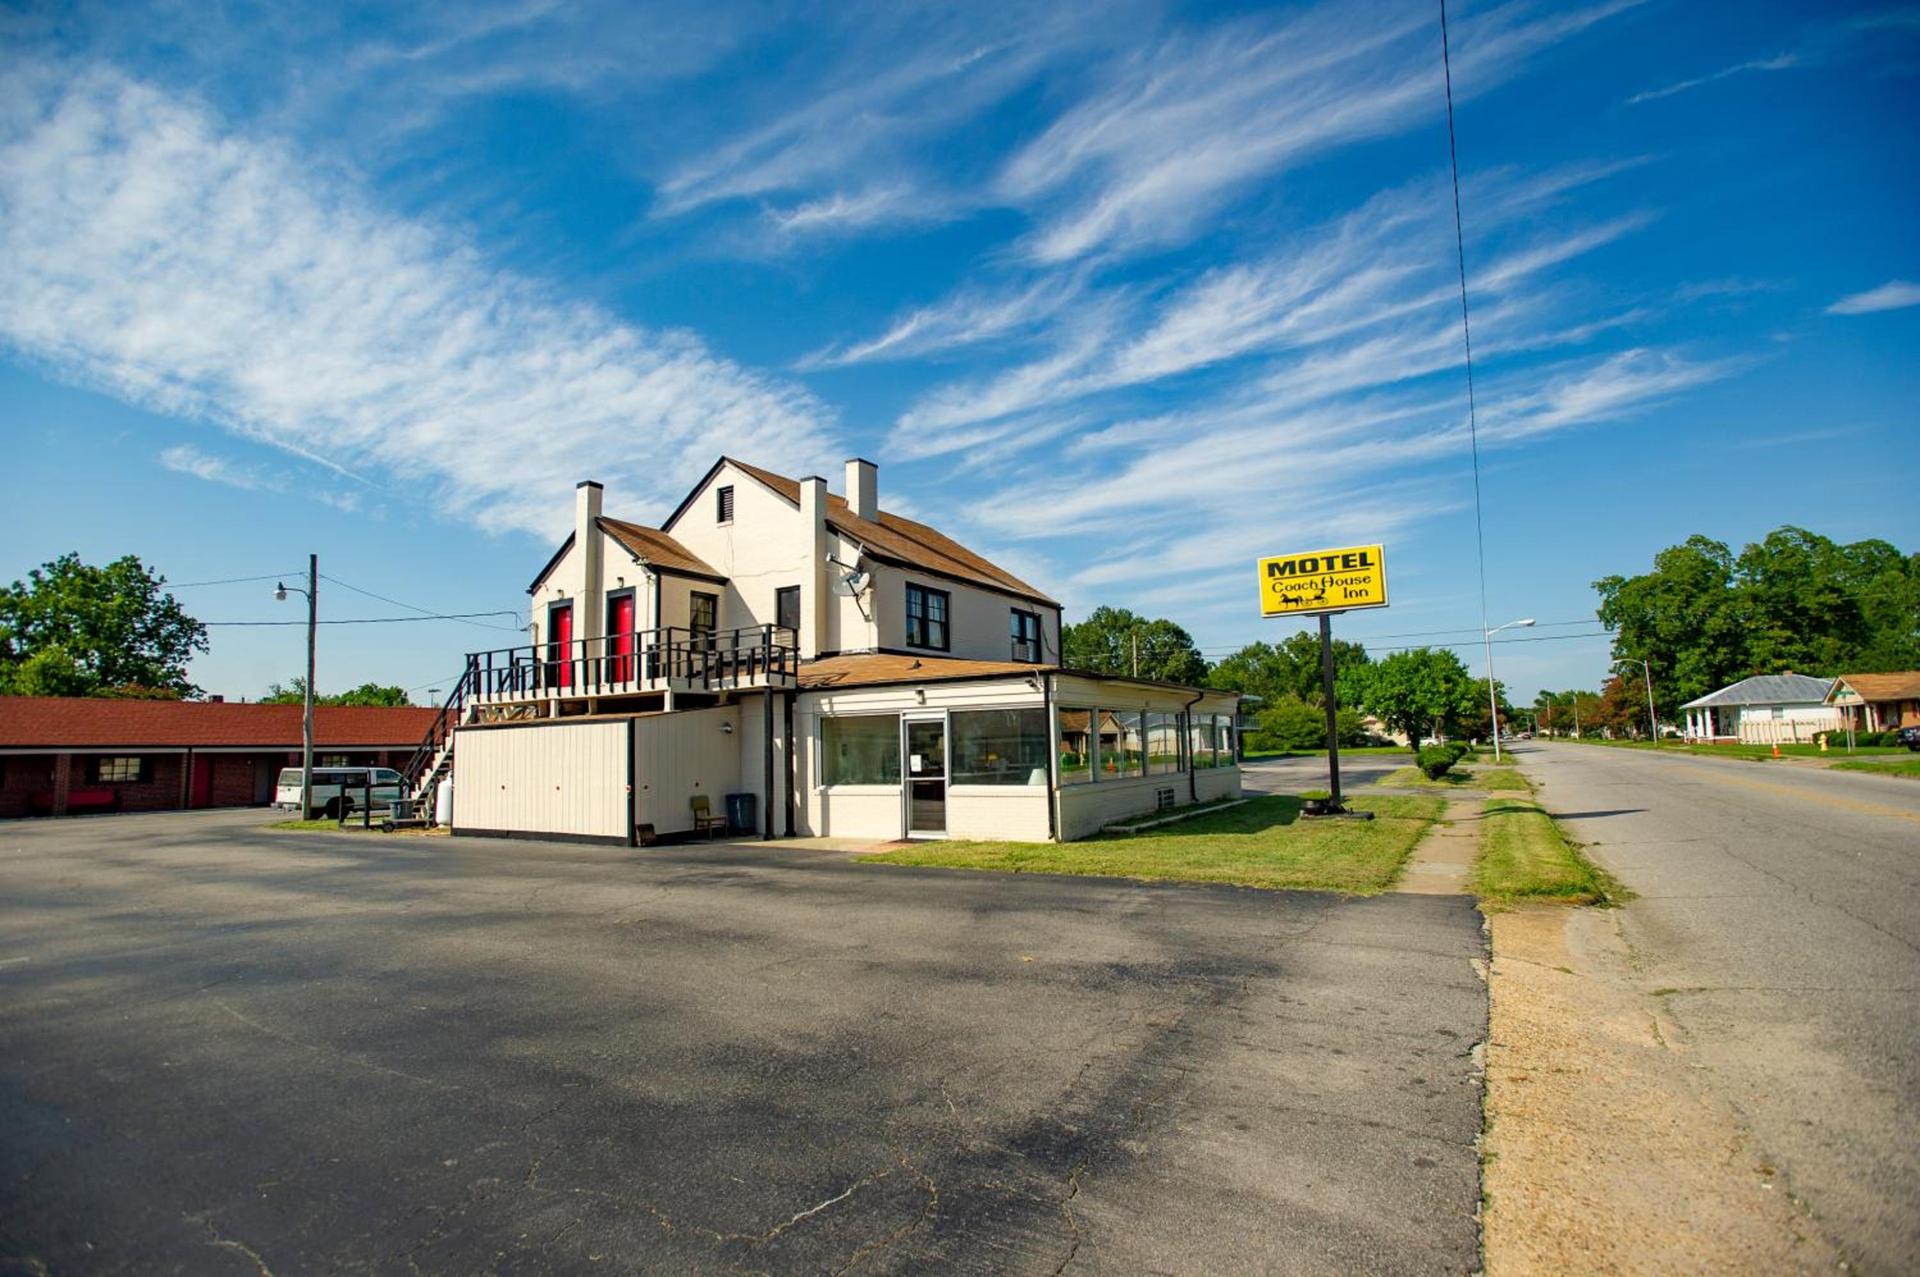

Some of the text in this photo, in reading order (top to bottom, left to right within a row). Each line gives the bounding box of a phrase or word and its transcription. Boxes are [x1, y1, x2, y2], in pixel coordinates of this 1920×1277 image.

[1267, 552, 1375, 578] MOTEL
[1272, 575, 1372, 594] Coach House
[1343, 587, 1369, 599] Inn
